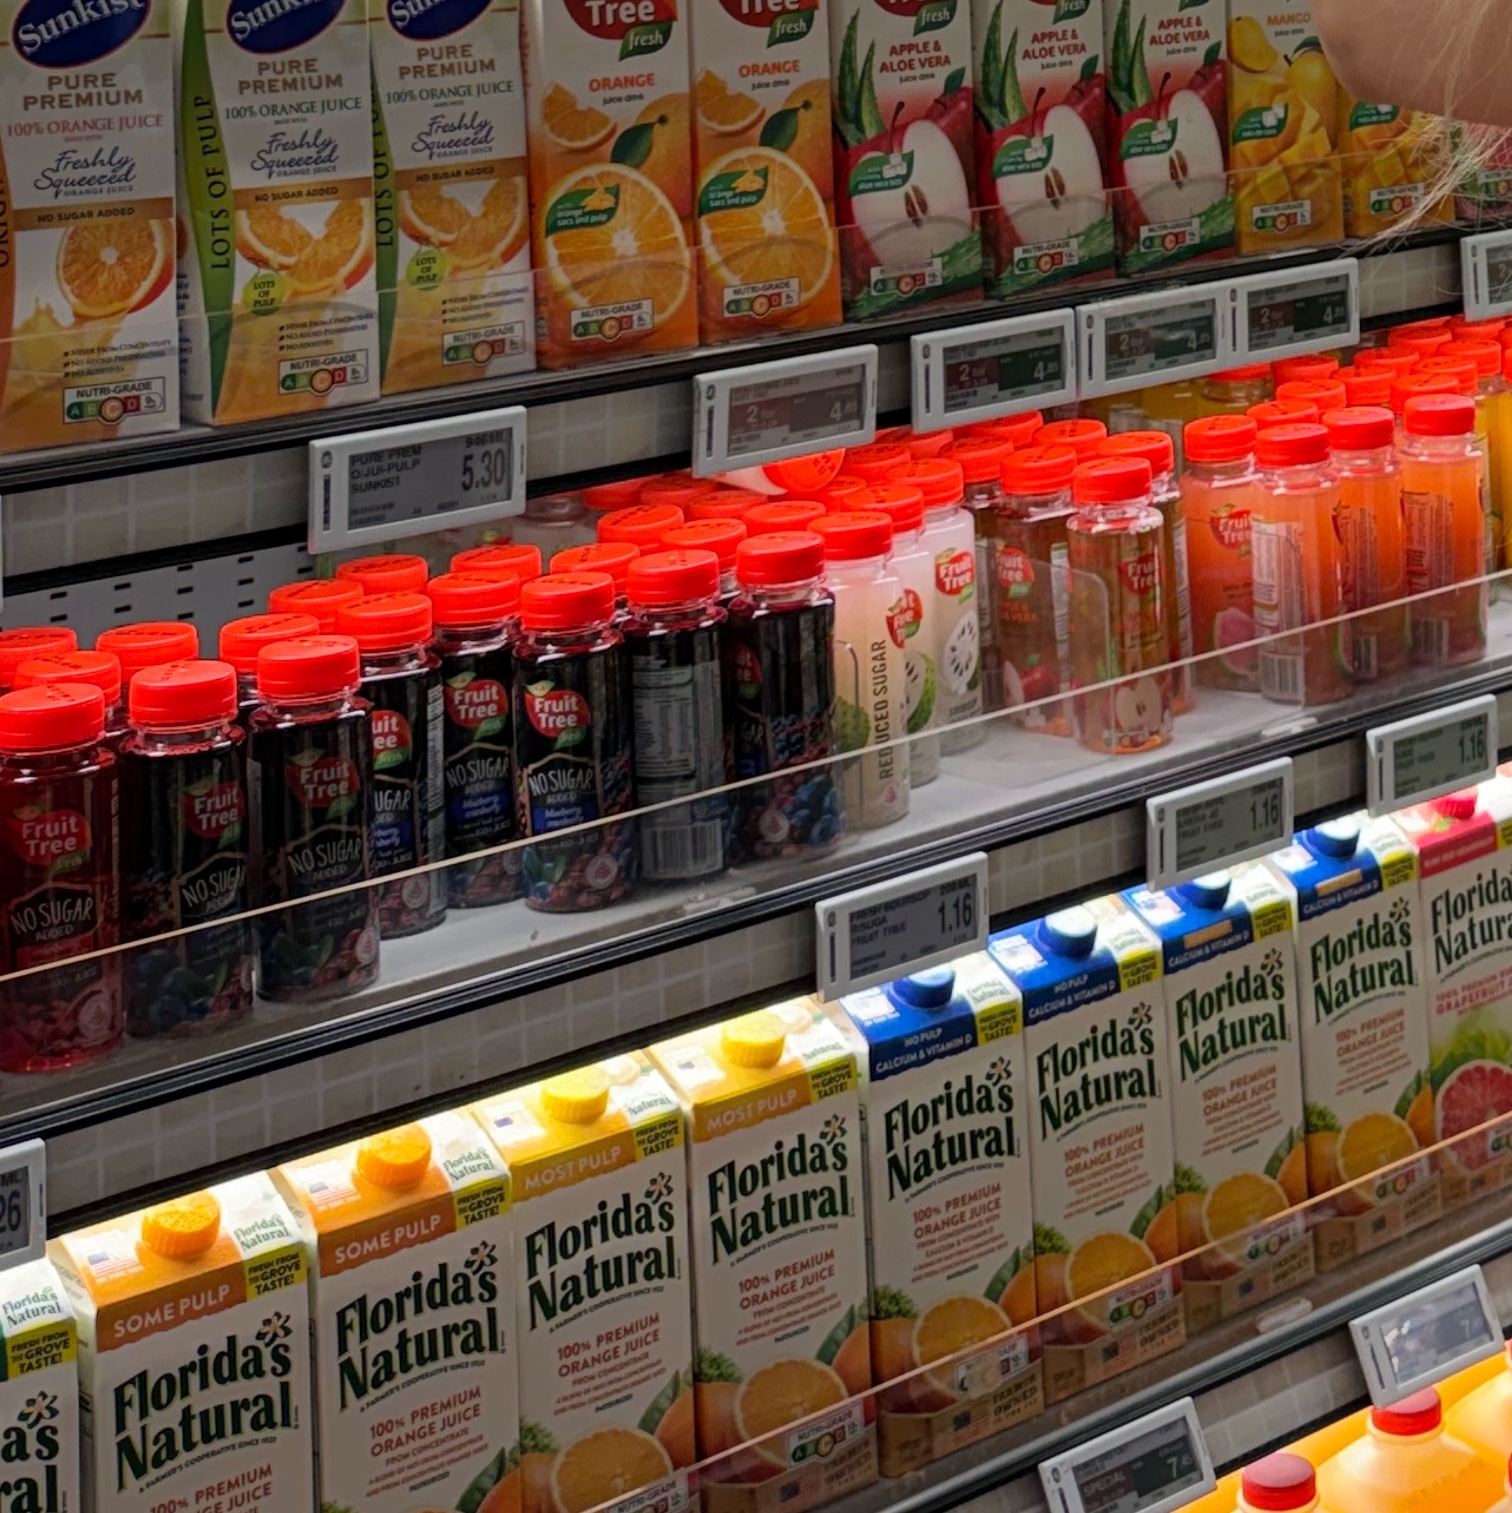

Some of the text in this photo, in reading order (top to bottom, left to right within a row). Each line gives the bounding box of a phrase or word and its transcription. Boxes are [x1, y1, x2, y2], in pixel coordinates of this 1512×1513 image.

[586, 0, 655, 26] Tree
[922, 7, 950, 24] fresh
[1267, 12, 1312, 26] MANGO
[628, 31, 663, 49] fresh
[889, 42, 930, 56] APPLE
[880, 55, 950, 74] ALOE VERA
[589, 73, 655, 92] ORANGE
[602, 94, 622, 106] juice
[7, 115, 164, 136] 100% ORANGE JUICE
[55, 146, 131, 172] Freshly
[34, 167, 136, 198] Squeezed
[194, 96, 230, 269] LOTS OF PULP
[77, 381, 152, 398] NUTRI-GRADE
[461, 449, 505, 492] 5.30
[533, 694, 580, 714] Fruit
[872, 639, 894, 780] REDUCED SUGAR
[537, 711, 579, 729] Tree
[529, 769, 595, 797] NO SUGAR
[22, 816, 79, 839] Fruit
[26, 836, 77, 855] Tree
[939, 892, 972, 934] 1.16
[883, 1075, 1015, 1158] Florida's
[525, 1146, 622, 1191] MOST PULP
[887, 1116, 1016, 1202] Natural
[526, 1192, 675, 1279] Florida's
[261, 1259, 301, 1284] GROVE
[528, 1236, 677, 1333] Natural
[113, 1284, 231, 1339] SOME PULP
[558, 1312, 661, 1360] 100% PREMIUM
[558, 1330, 661, 1378] ORANGE JUICE
[113, 1335, 292, 1437] Florida's
[115, 1381, 293, 1494] Natural
